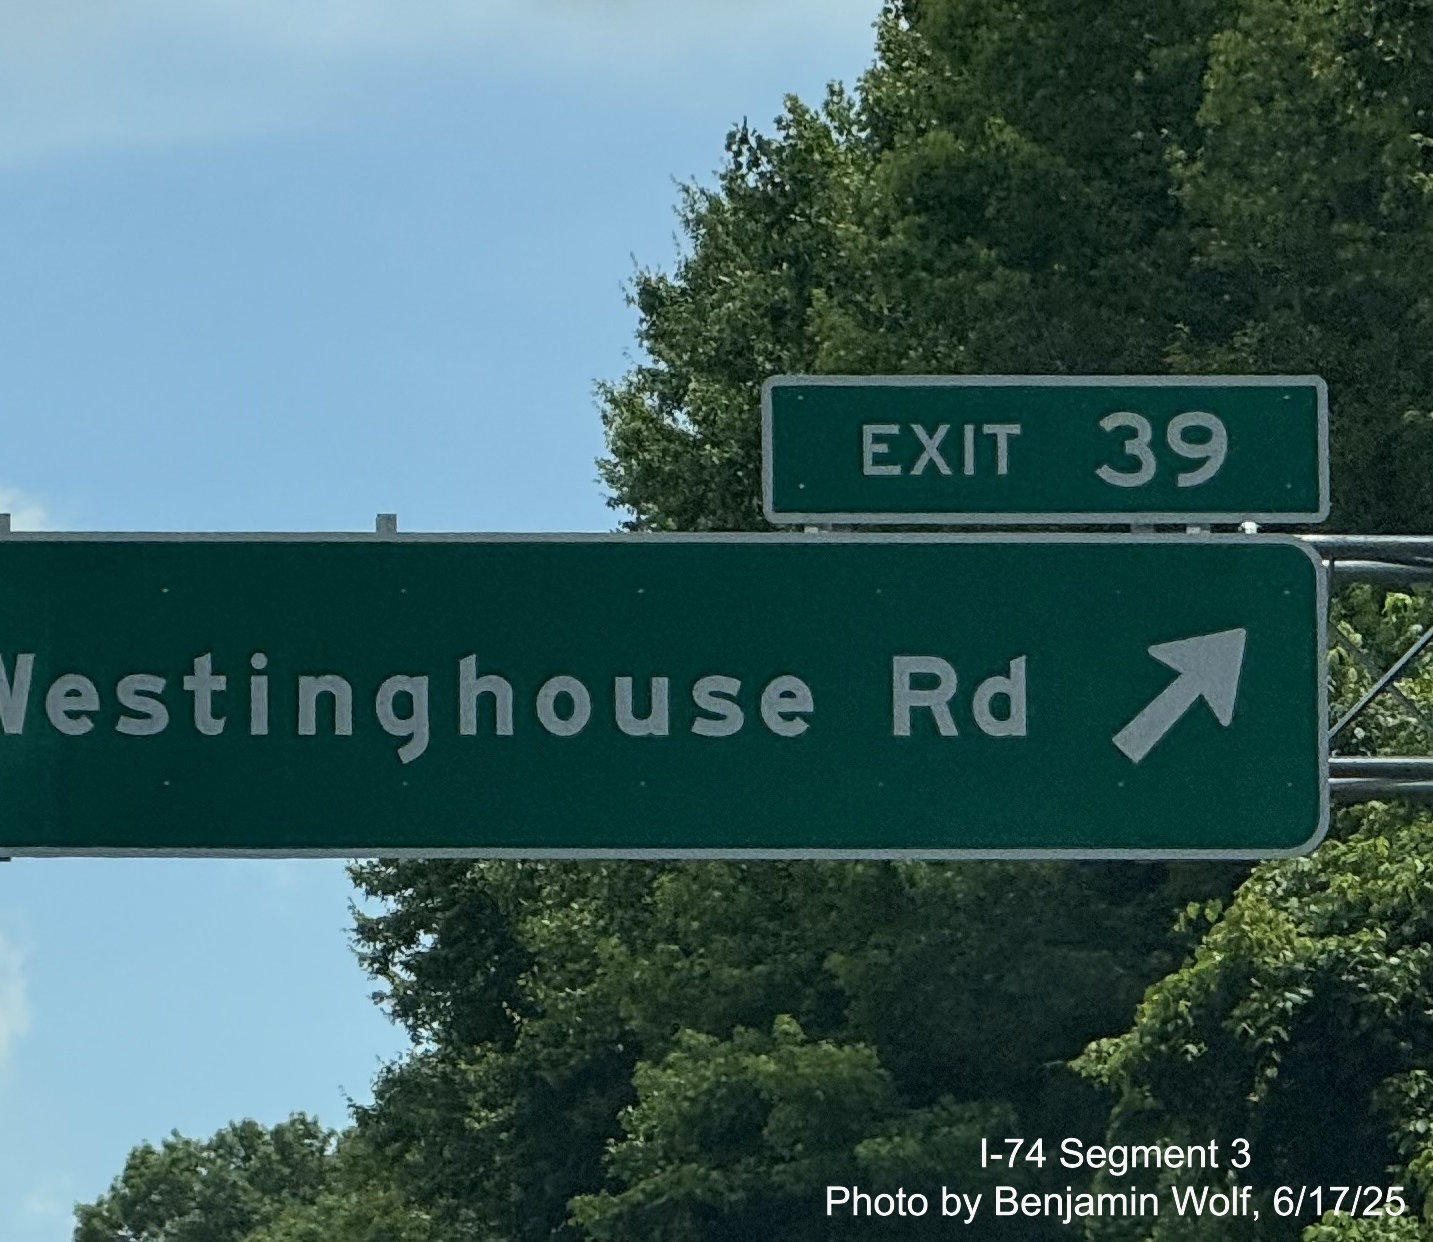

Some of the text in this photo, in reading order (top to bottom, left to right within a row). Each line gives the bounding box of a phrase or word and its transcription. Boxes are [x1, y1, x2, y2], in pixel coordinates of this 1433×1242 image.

[862, 410, 1229, 488] EXIT 39
[892, 654, 1028, 737] Rd
